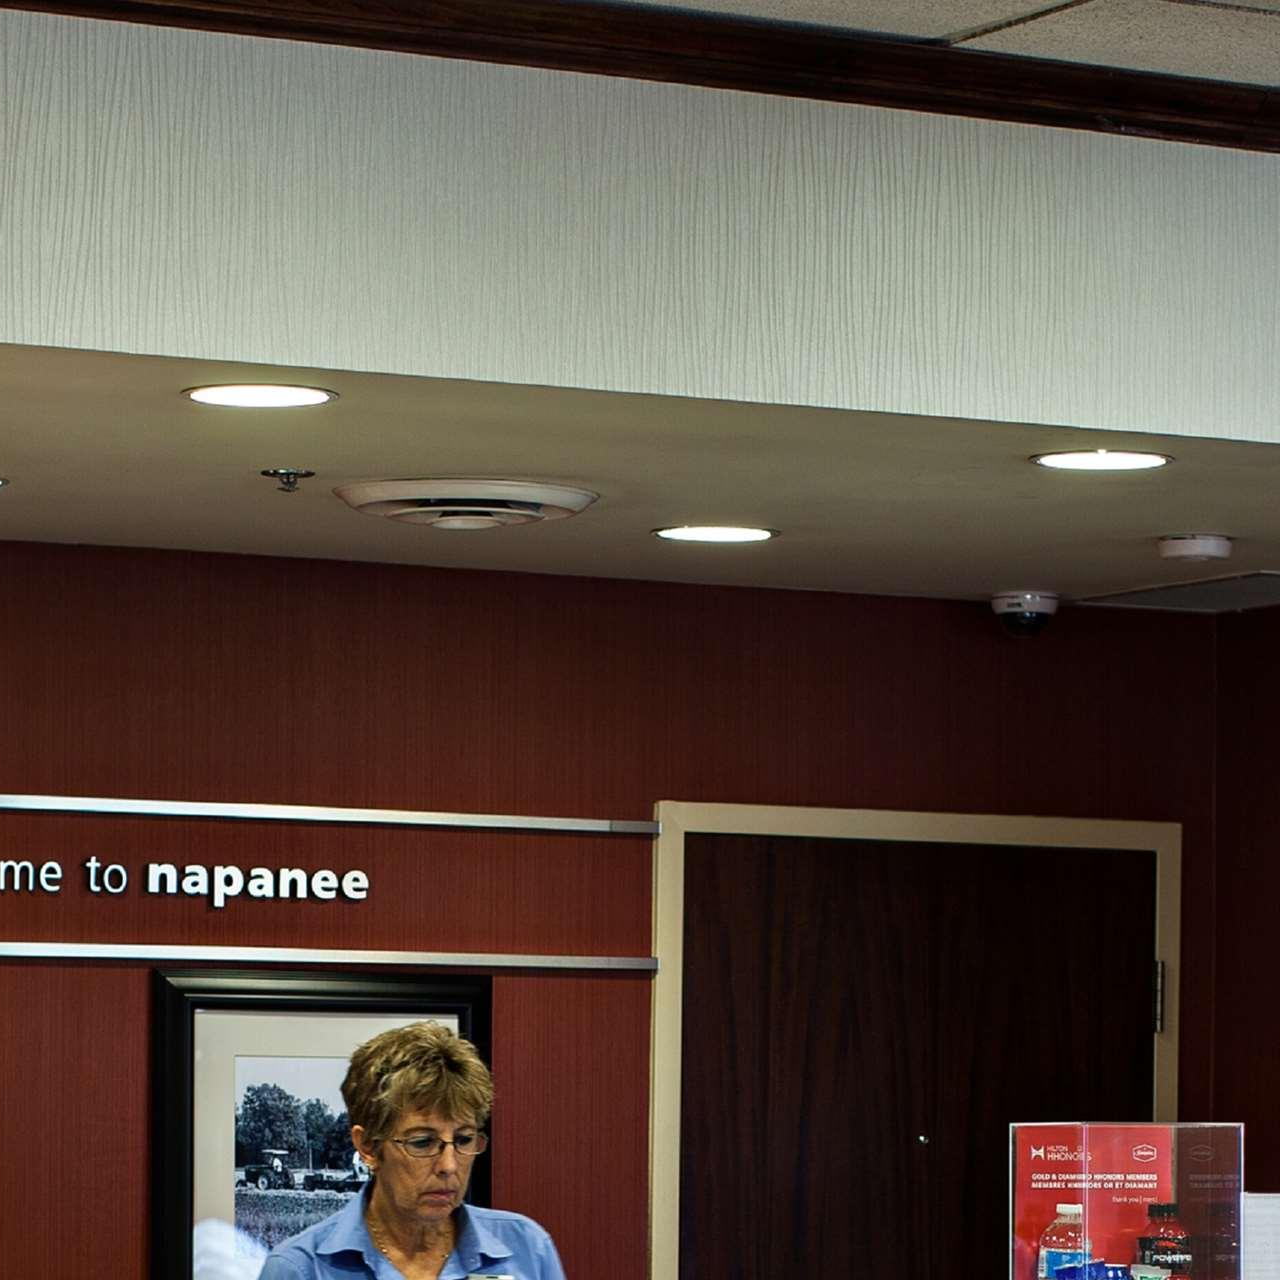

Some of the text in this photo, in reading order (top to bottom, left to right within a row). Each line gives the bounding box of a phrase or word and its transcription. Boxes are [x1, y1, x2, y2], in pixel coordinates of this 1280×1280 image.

[85, 855, 128, 894] to
[146, 861, 370, 908] napanee
[1031, 1173, 1050, 1181] GOLD
[1051, 1173, 1057, 1181] &
[1093, 1173, 1125, 1181] HHONORS
[1126, 1173, 1158, 1181] MEMBERS
[1031, 1181, 1066, 1189] MEMBRES
[1103, 1181, 1114, 1189] OR
[1115, 1181, 1124, 1189] ET
[1124, 1181, 1158, 1189] DIAMANT
